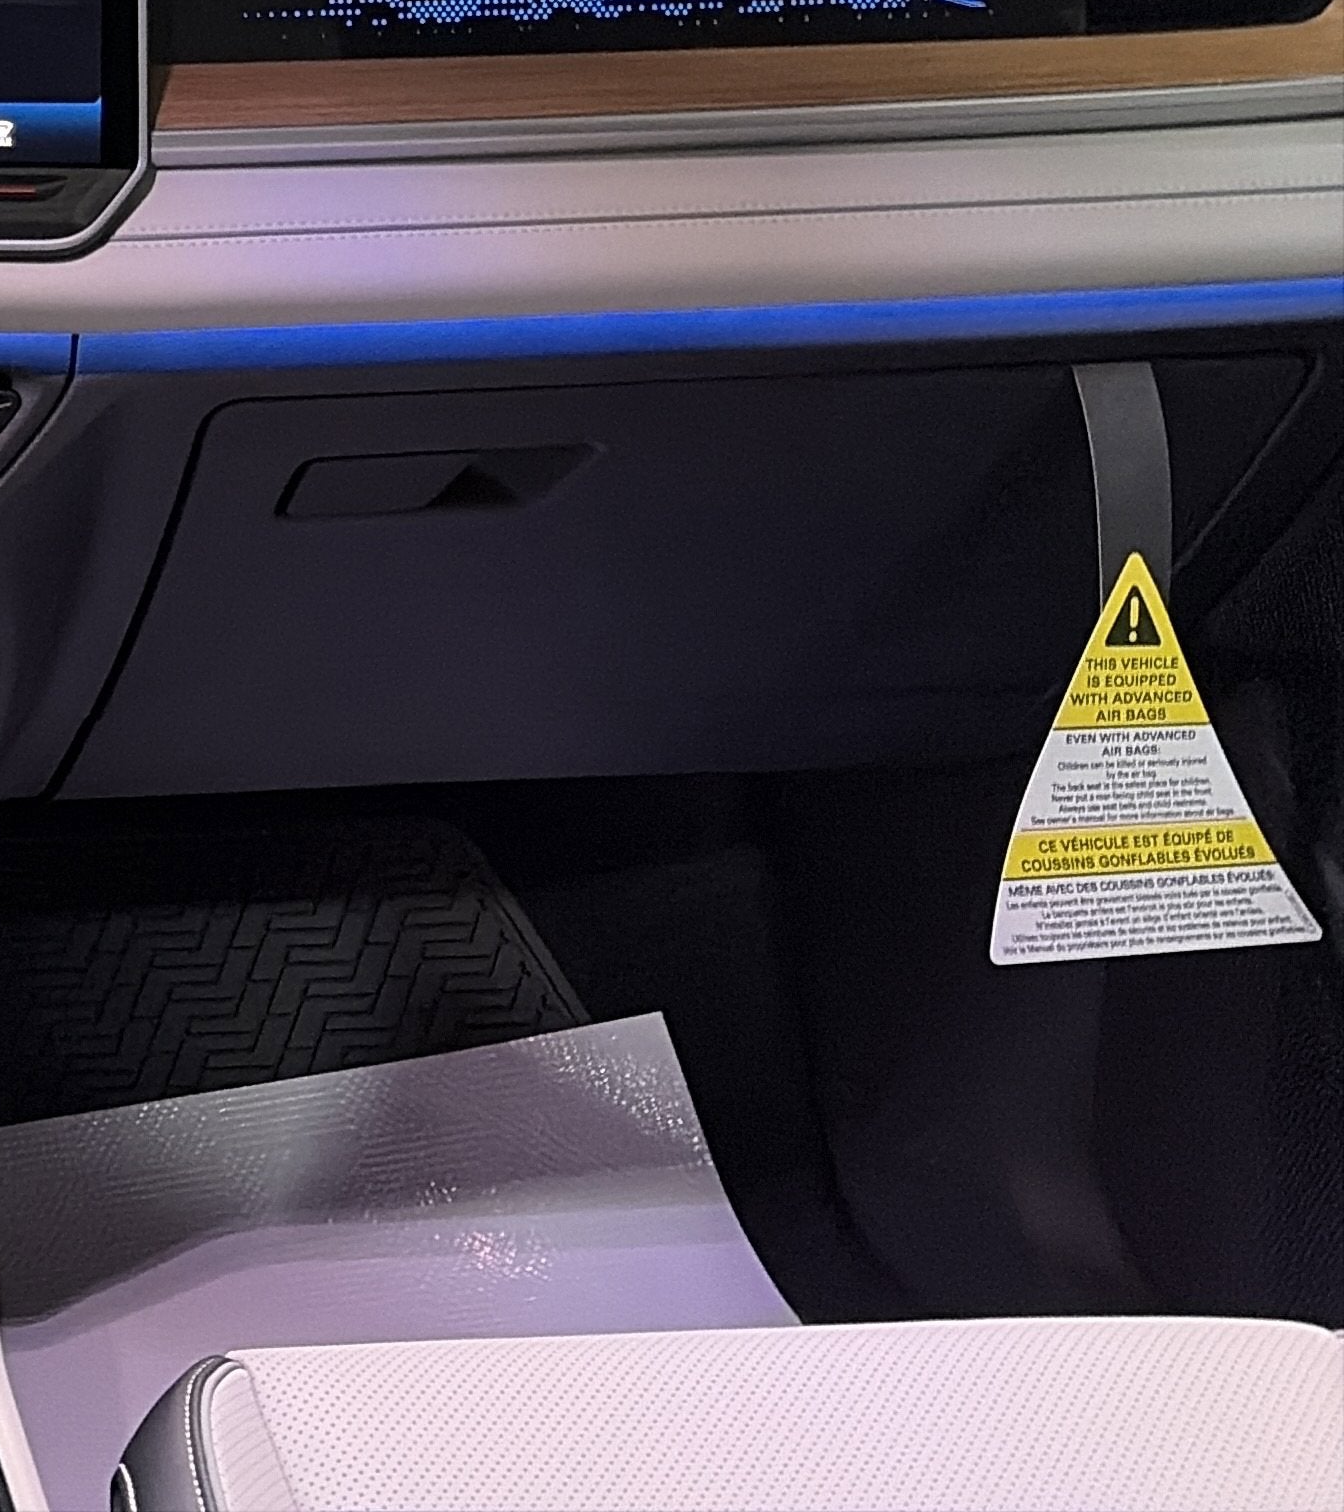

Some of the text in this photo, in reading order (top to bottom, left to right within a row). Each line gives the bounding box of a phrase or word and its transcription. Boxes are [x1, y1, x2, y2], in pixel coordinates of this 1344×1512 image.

[1085, 656, 1179, 671] THIS VEHICLE
[1087, 673, 1177, 688] IS EQUIPPED
[1071, 690, 1193, 706] WITH ADVANCED
[1095, 708, 1167, 722] AIR BAGS
[1066, 730, 1196, 744] EVEN WITH ADVANCED
[1101, 746, 1122, 756] AIR
[1038, 829, 1234, 853] CE VÉHICULE EST ÉQUIPÉ DE
[1021, 845, 1256, 873] COUSSINS GONFLABLES ÉVOLUÉS
[1046, 883, 1075, 895] AVEC
[1076, 882, 1098, 894] DES
[1156, 873, 1225, 888] GONFLABLES
